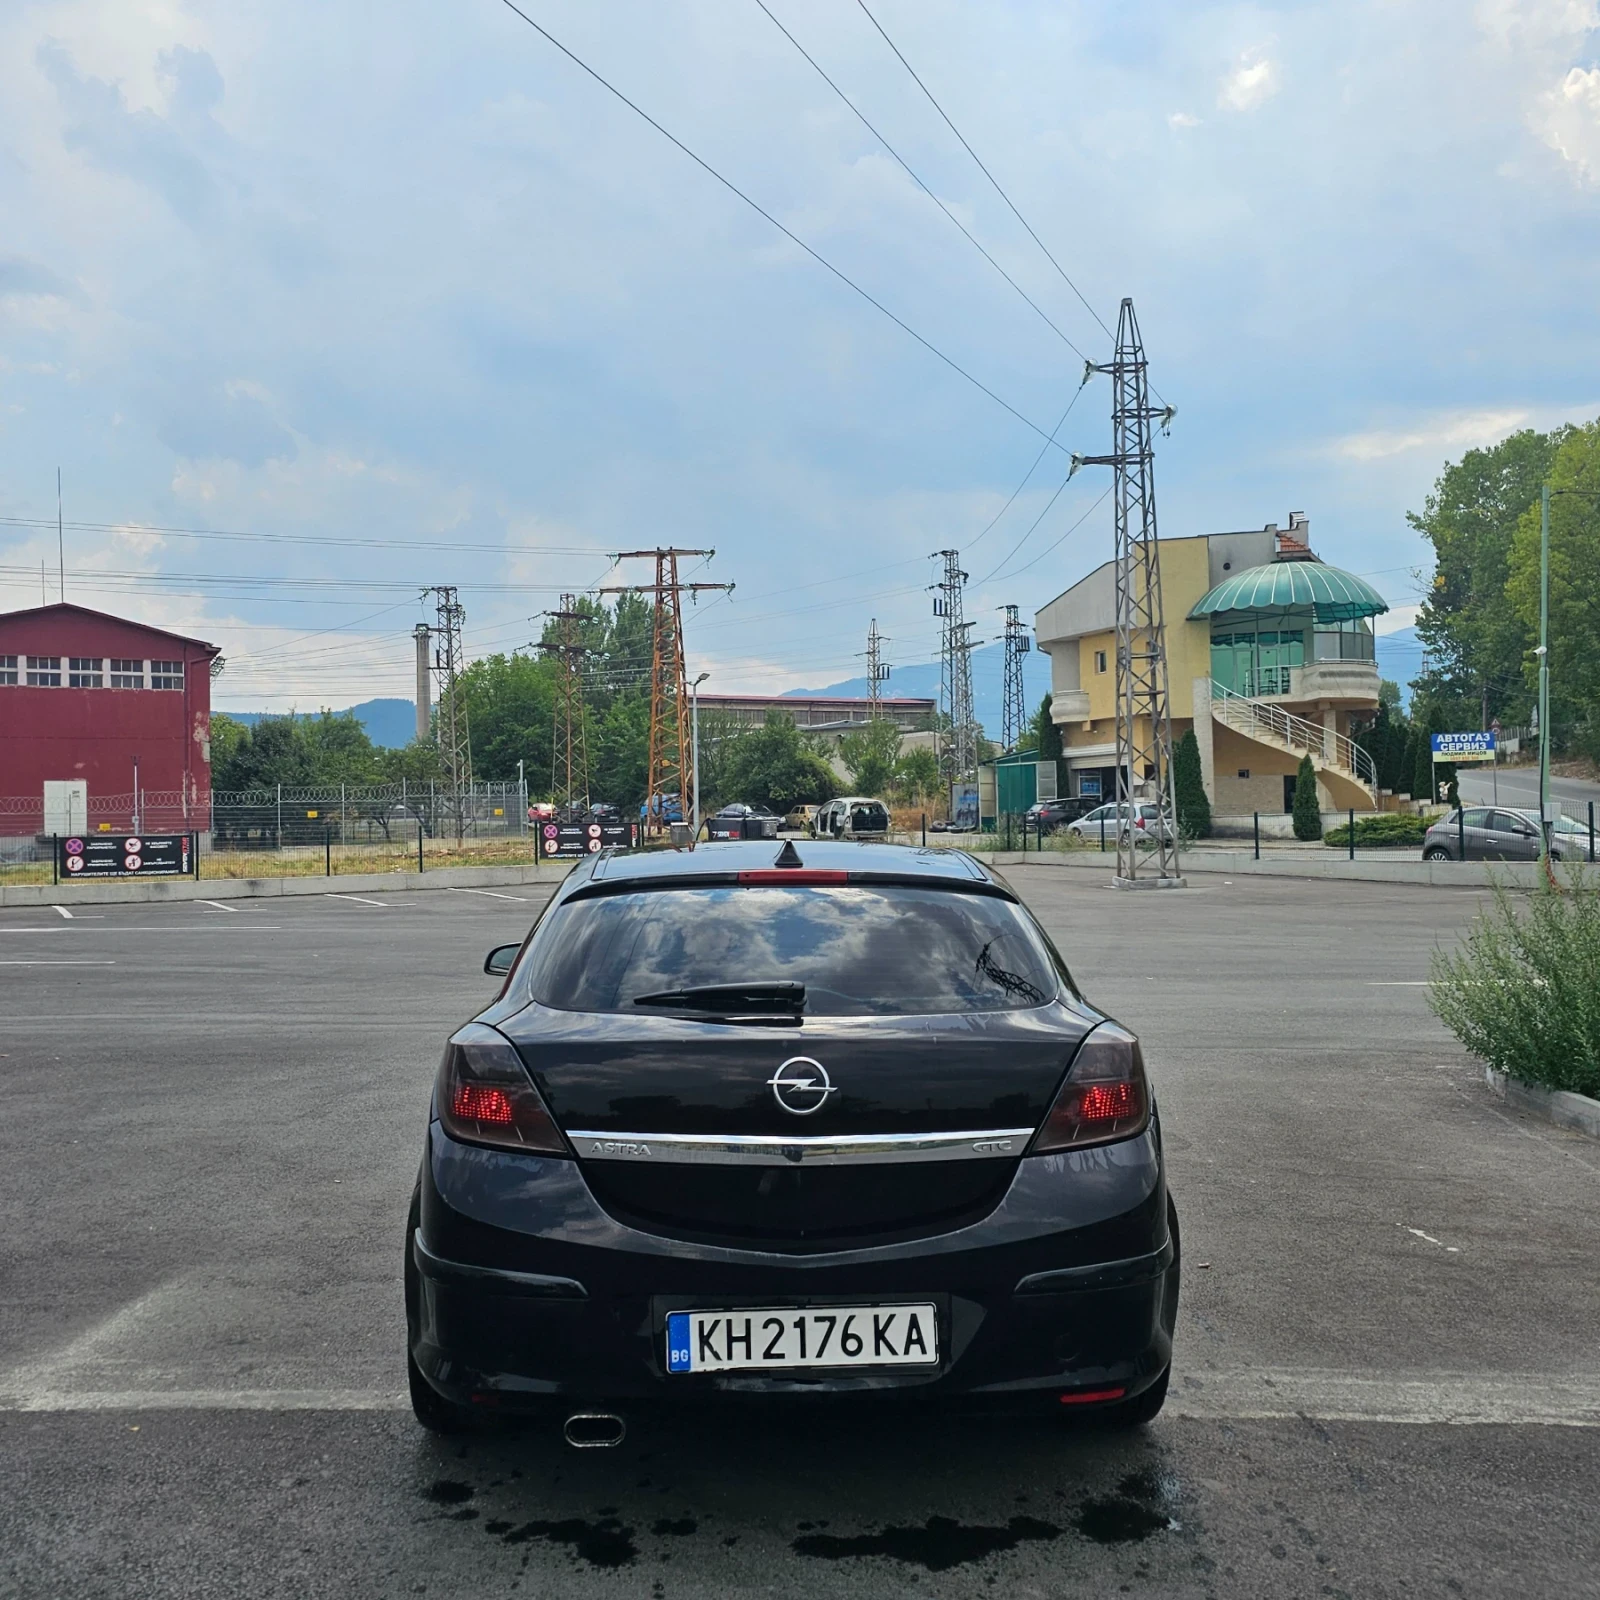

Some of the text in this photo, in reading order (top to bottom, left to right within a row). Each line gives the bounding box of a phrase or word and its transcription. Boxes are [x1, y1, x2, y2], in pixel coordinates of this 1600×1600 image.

[1436, 733, 1491, 743] АВТОГАЗ
[1440, 742, 1487, 751] СЕРВИЗ
[591, 1141, 652, 1156] ASTRA
[972, 1140, 1012, 1152] GTC
[671, 1349, 689, 1363] BG
